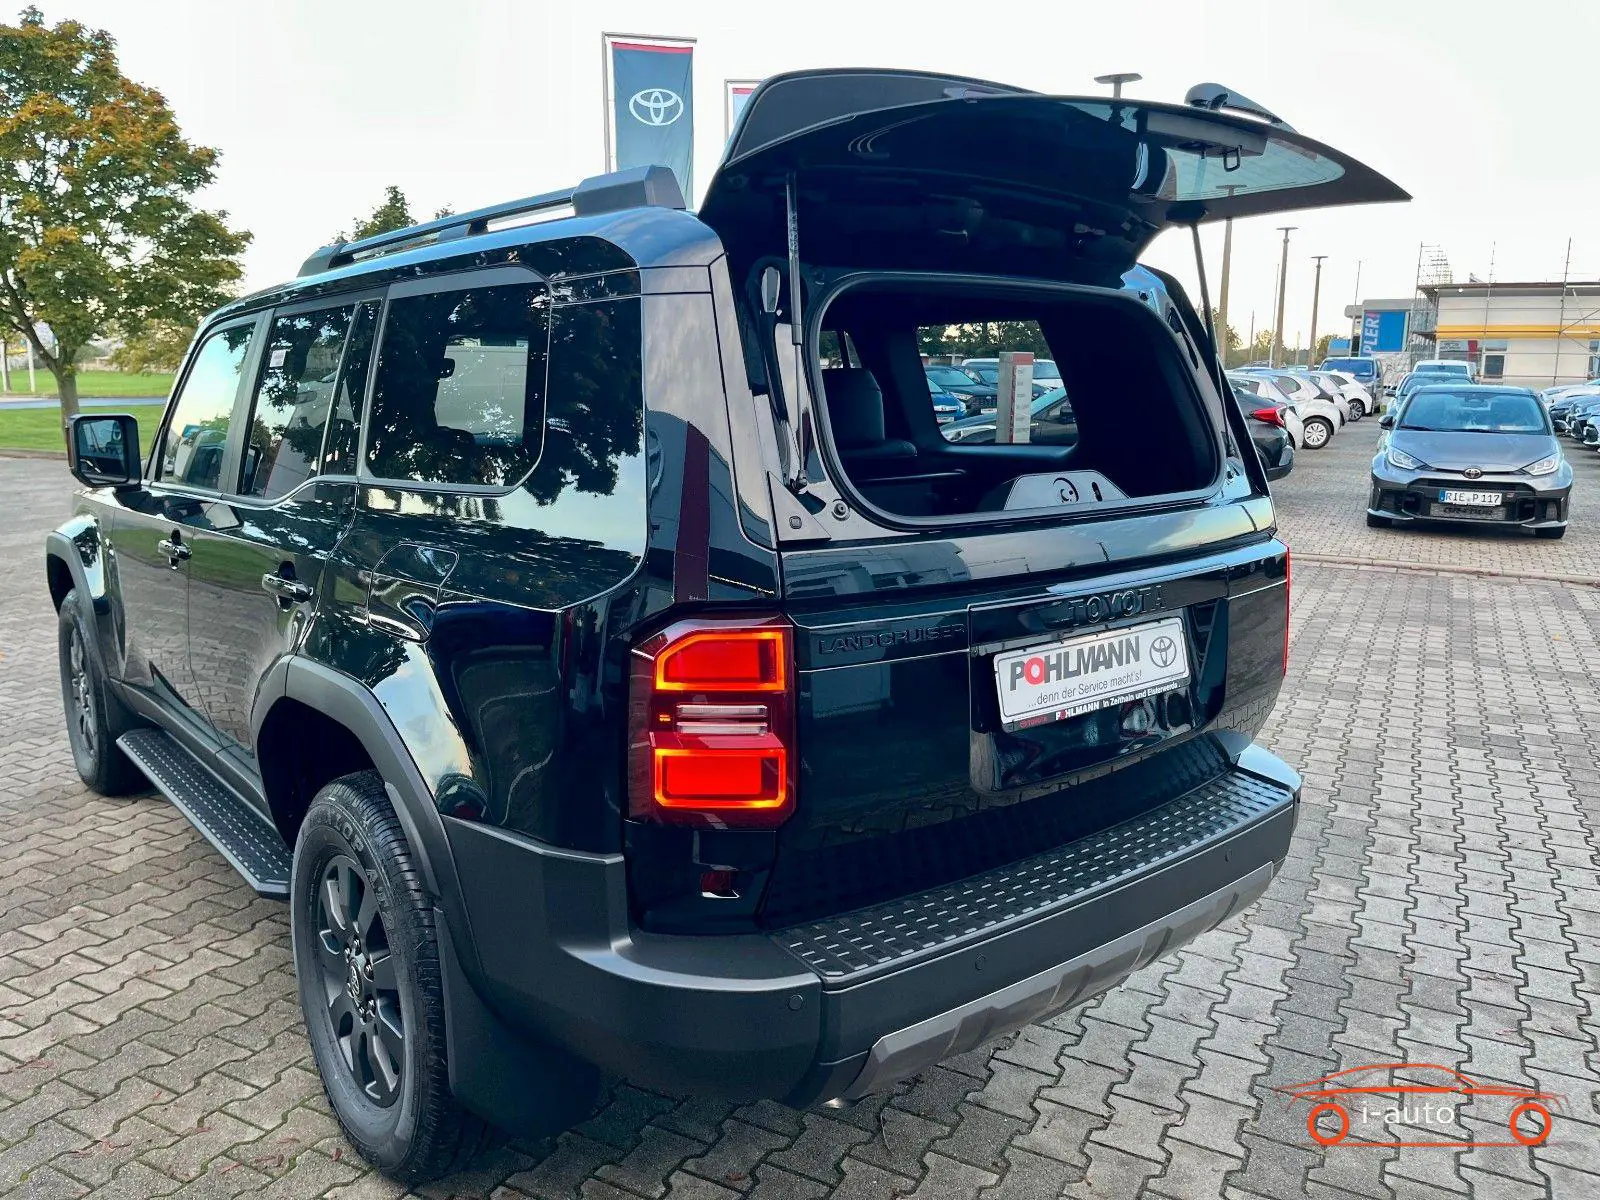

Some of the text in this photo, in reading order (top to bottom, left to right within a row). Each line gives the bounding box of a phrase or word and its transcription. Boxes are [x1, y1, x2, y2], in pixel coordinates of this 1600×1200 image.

[1446, 493, 1465, 502] RIE
[1069, 585, 1165, 626] TOYOTA
[1009, 636, 1141, 691] POHLMANN
[1061, 685, 1077, 699] der
[1078, 680, 1108, 695] Service
[1055, 701, 1100, 721] POHLMANN
[1136, 690, 1147, 700] und
